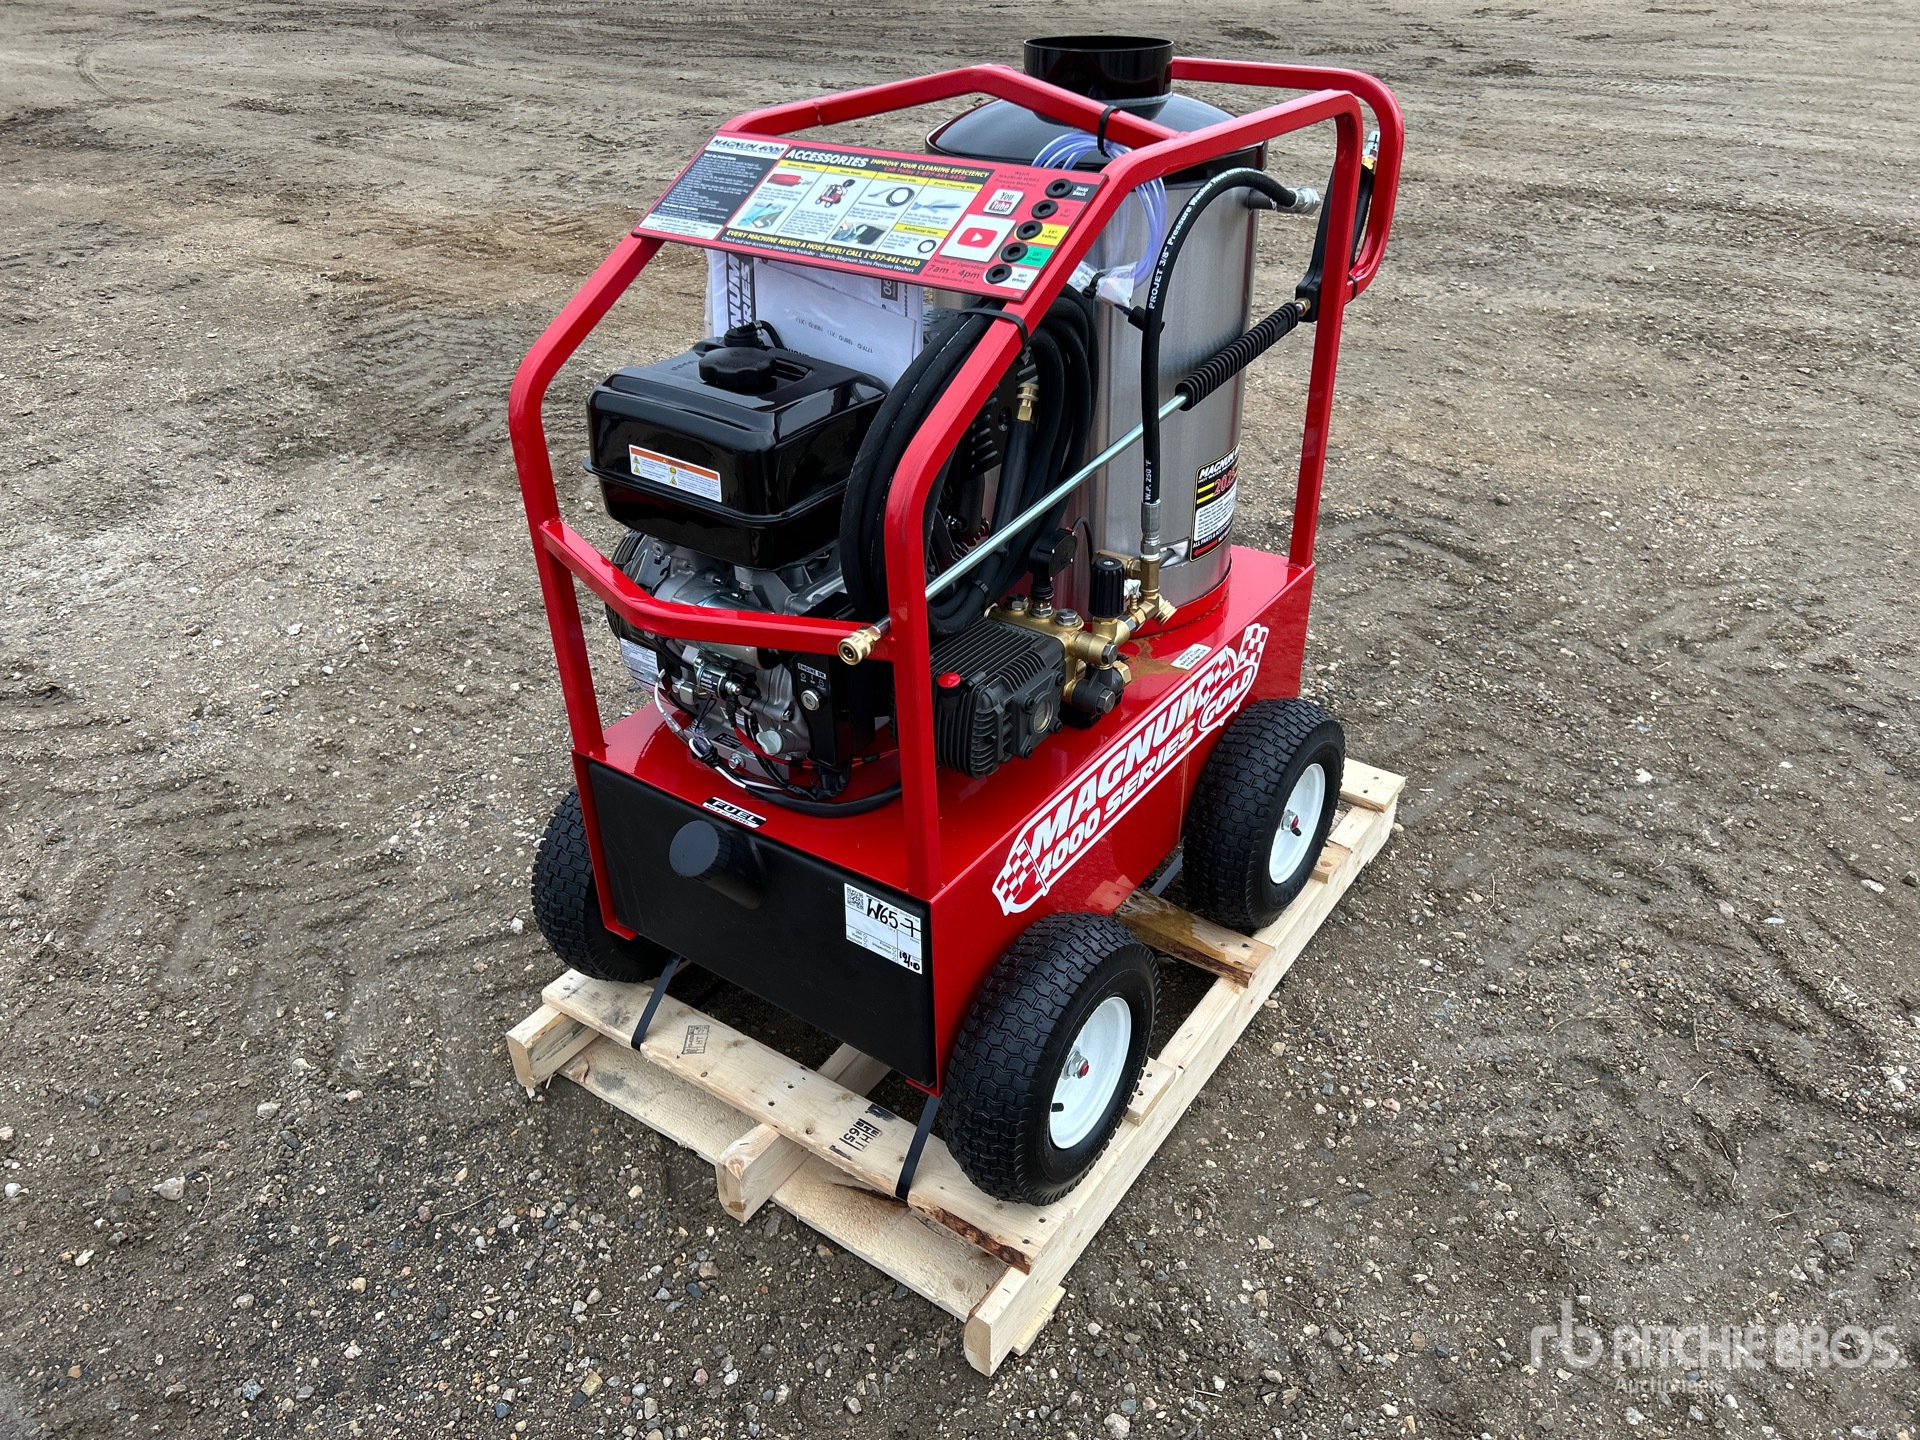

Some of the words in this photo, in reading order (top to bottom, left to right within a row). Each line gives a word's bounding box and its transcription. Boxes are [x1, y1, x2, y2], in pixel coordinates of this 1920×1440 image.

[786, 149, 869, 168] ACCESSORIES
[870, 158, 899, 167] IMPROVE
[900, 162, 918, 170] YOUR
[918, 164, 950, 174] CLEANING
[950, 168, 990, 178] EFFICIENCY
[991, 201, 1011, 212] Tube
[1000, 192, 1014, 201] You
[726, 230, 748, 240] EVERY
[748, 233, 778, 244] MACHINE
[778, 238, 800, 247] NEEDS
[806, 243, 826, 252] HOSE
[826, 246, 845, 254] REEL!
[846, 250, 862, 258] CALL
[864, 252, 920, 267] 1-877-441-4430
[1148, 268, 1163, 310] PROJET
[1158, 247, 1170, 267] 3/8"
[1167, 207, 1192, 246] Pressure
[1188, 180, 1213, 206] Washer
[858, 258, 872, 266] Series
[872, 261, 894, 269] Pressure
[894, 264, 914, 272] Washers
[928, 264, 950, 274] 7am
[958, 270, 980, 279] 4pm
[728, 252, 742, 330] NUM
[740, 261, 751, 326] RIES
[1198, 450, 1234, 480] MAGNUM
[1192, 540, 1201, 549] ALL
[1201, 535, 1212, 546] PARTS
[1200, 666, 1253, 728] GOLD
[1030, 668, 1215, 861] MAGNUM
[712, 801, 757, 824] FUEL
[1035, 807, 1100, 886] 4000
[1102, 718, 1196, 821] SERIES
[855, 1133, 873, 1150] HT
